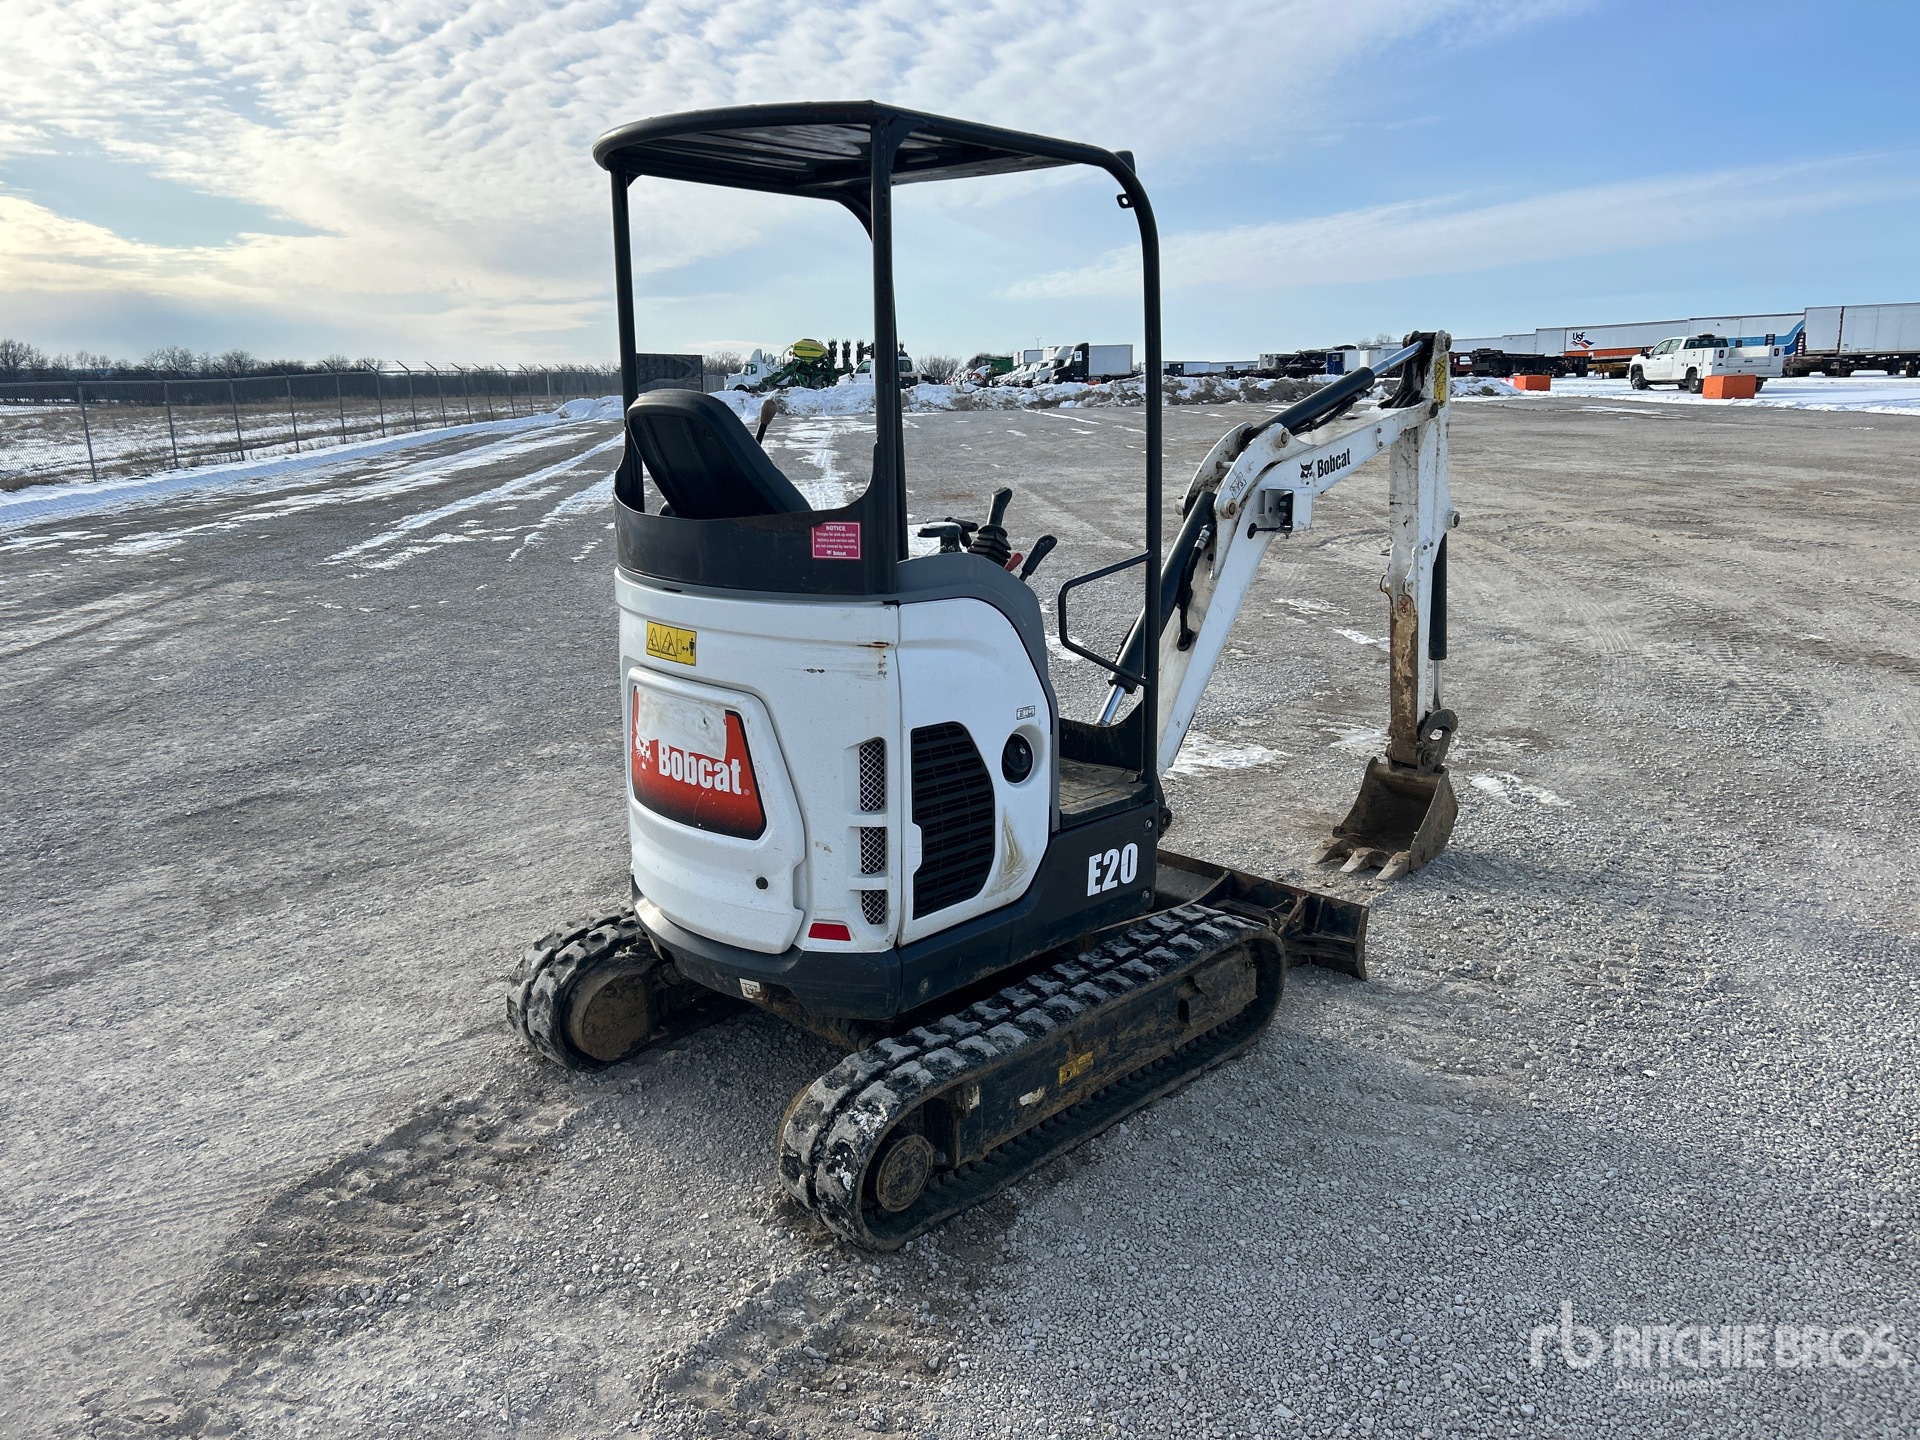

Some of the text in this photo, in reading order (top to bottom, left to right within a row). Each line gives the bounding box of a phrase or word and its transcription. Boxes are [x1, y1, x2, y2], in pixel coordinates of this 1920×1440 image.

[1317, 448, 1351, 478] Bobcat
[658, 738, 742, 795] Bobcat
[1087, 842, 1138, 897] E20
